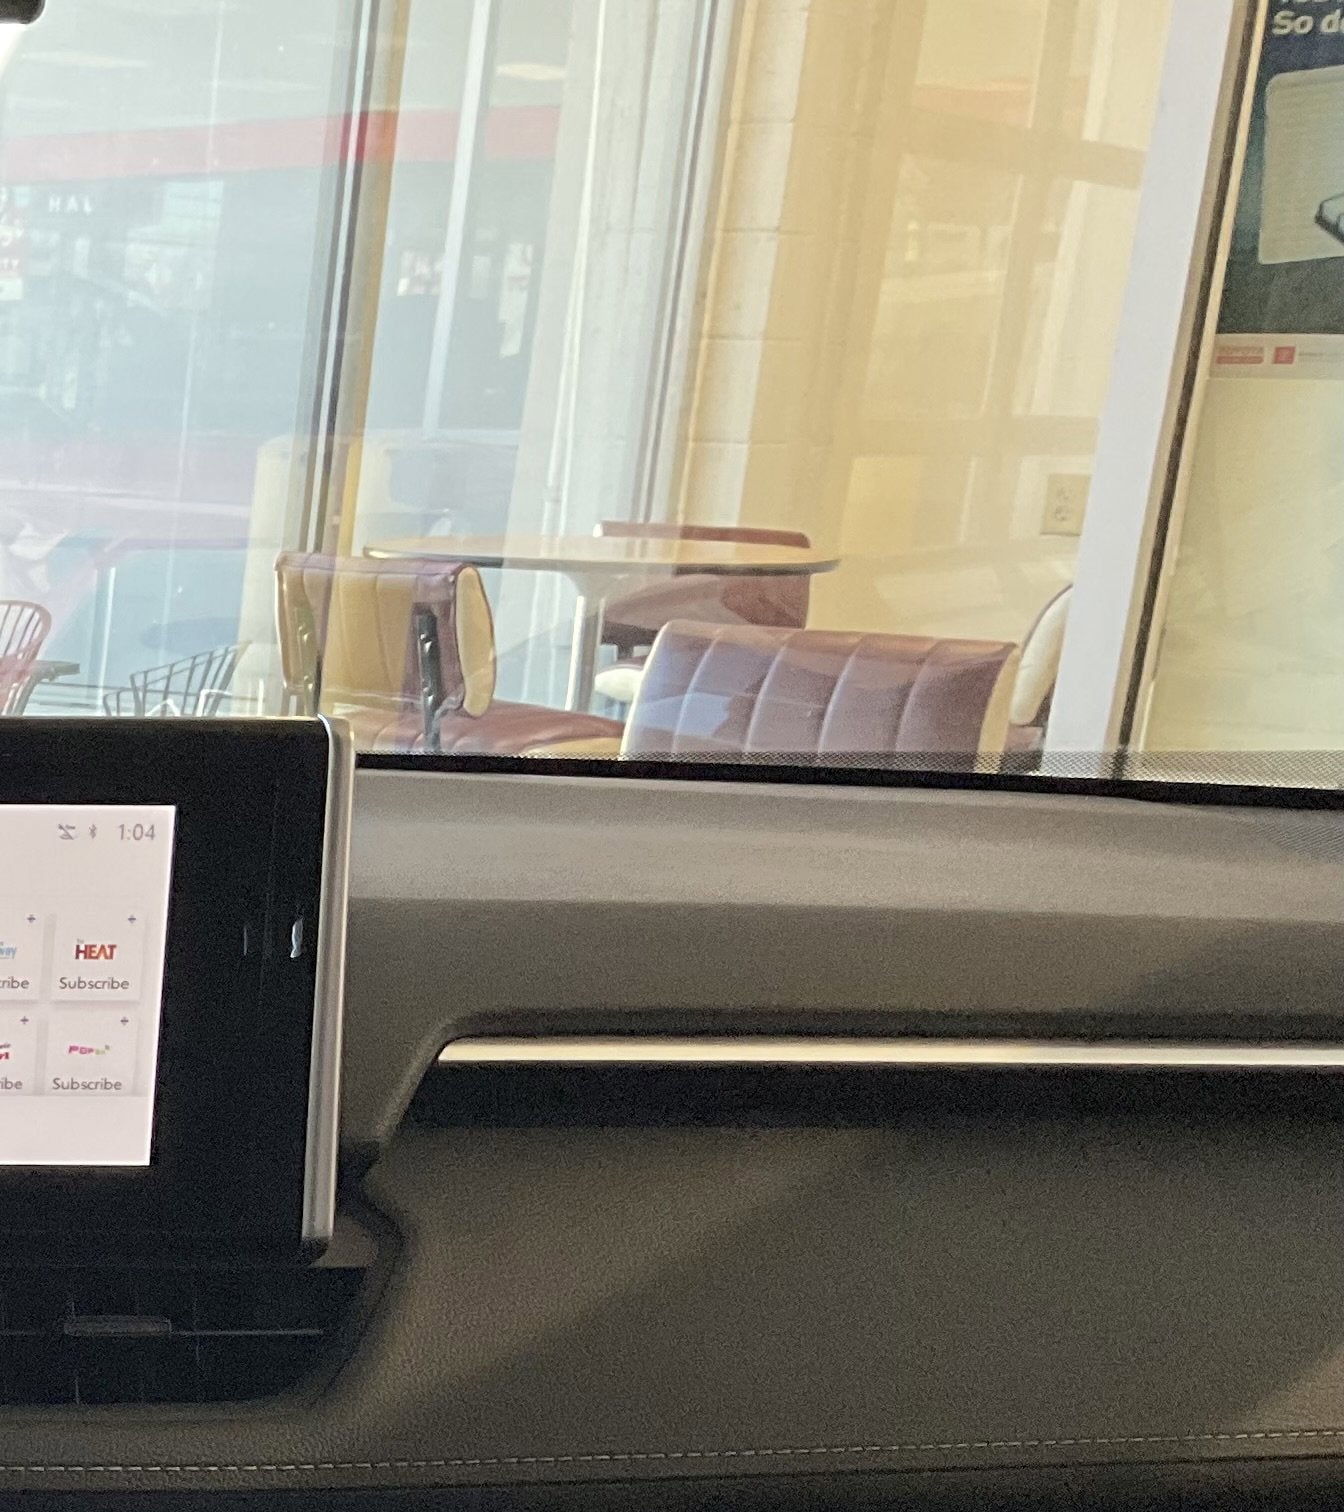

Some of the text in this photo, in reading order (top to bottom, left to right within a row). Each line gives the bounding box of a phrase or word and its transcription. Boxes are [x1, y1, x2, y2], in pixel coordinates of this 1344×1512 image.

[1272, 9, 1344, 35] So d
[117, 823, 157, 842] 1:04
[75, 944, 118, 960] HEAT
[59, 976, 130, 990] Subscribe
[52, 1077, 123, 1091] Subscribe
